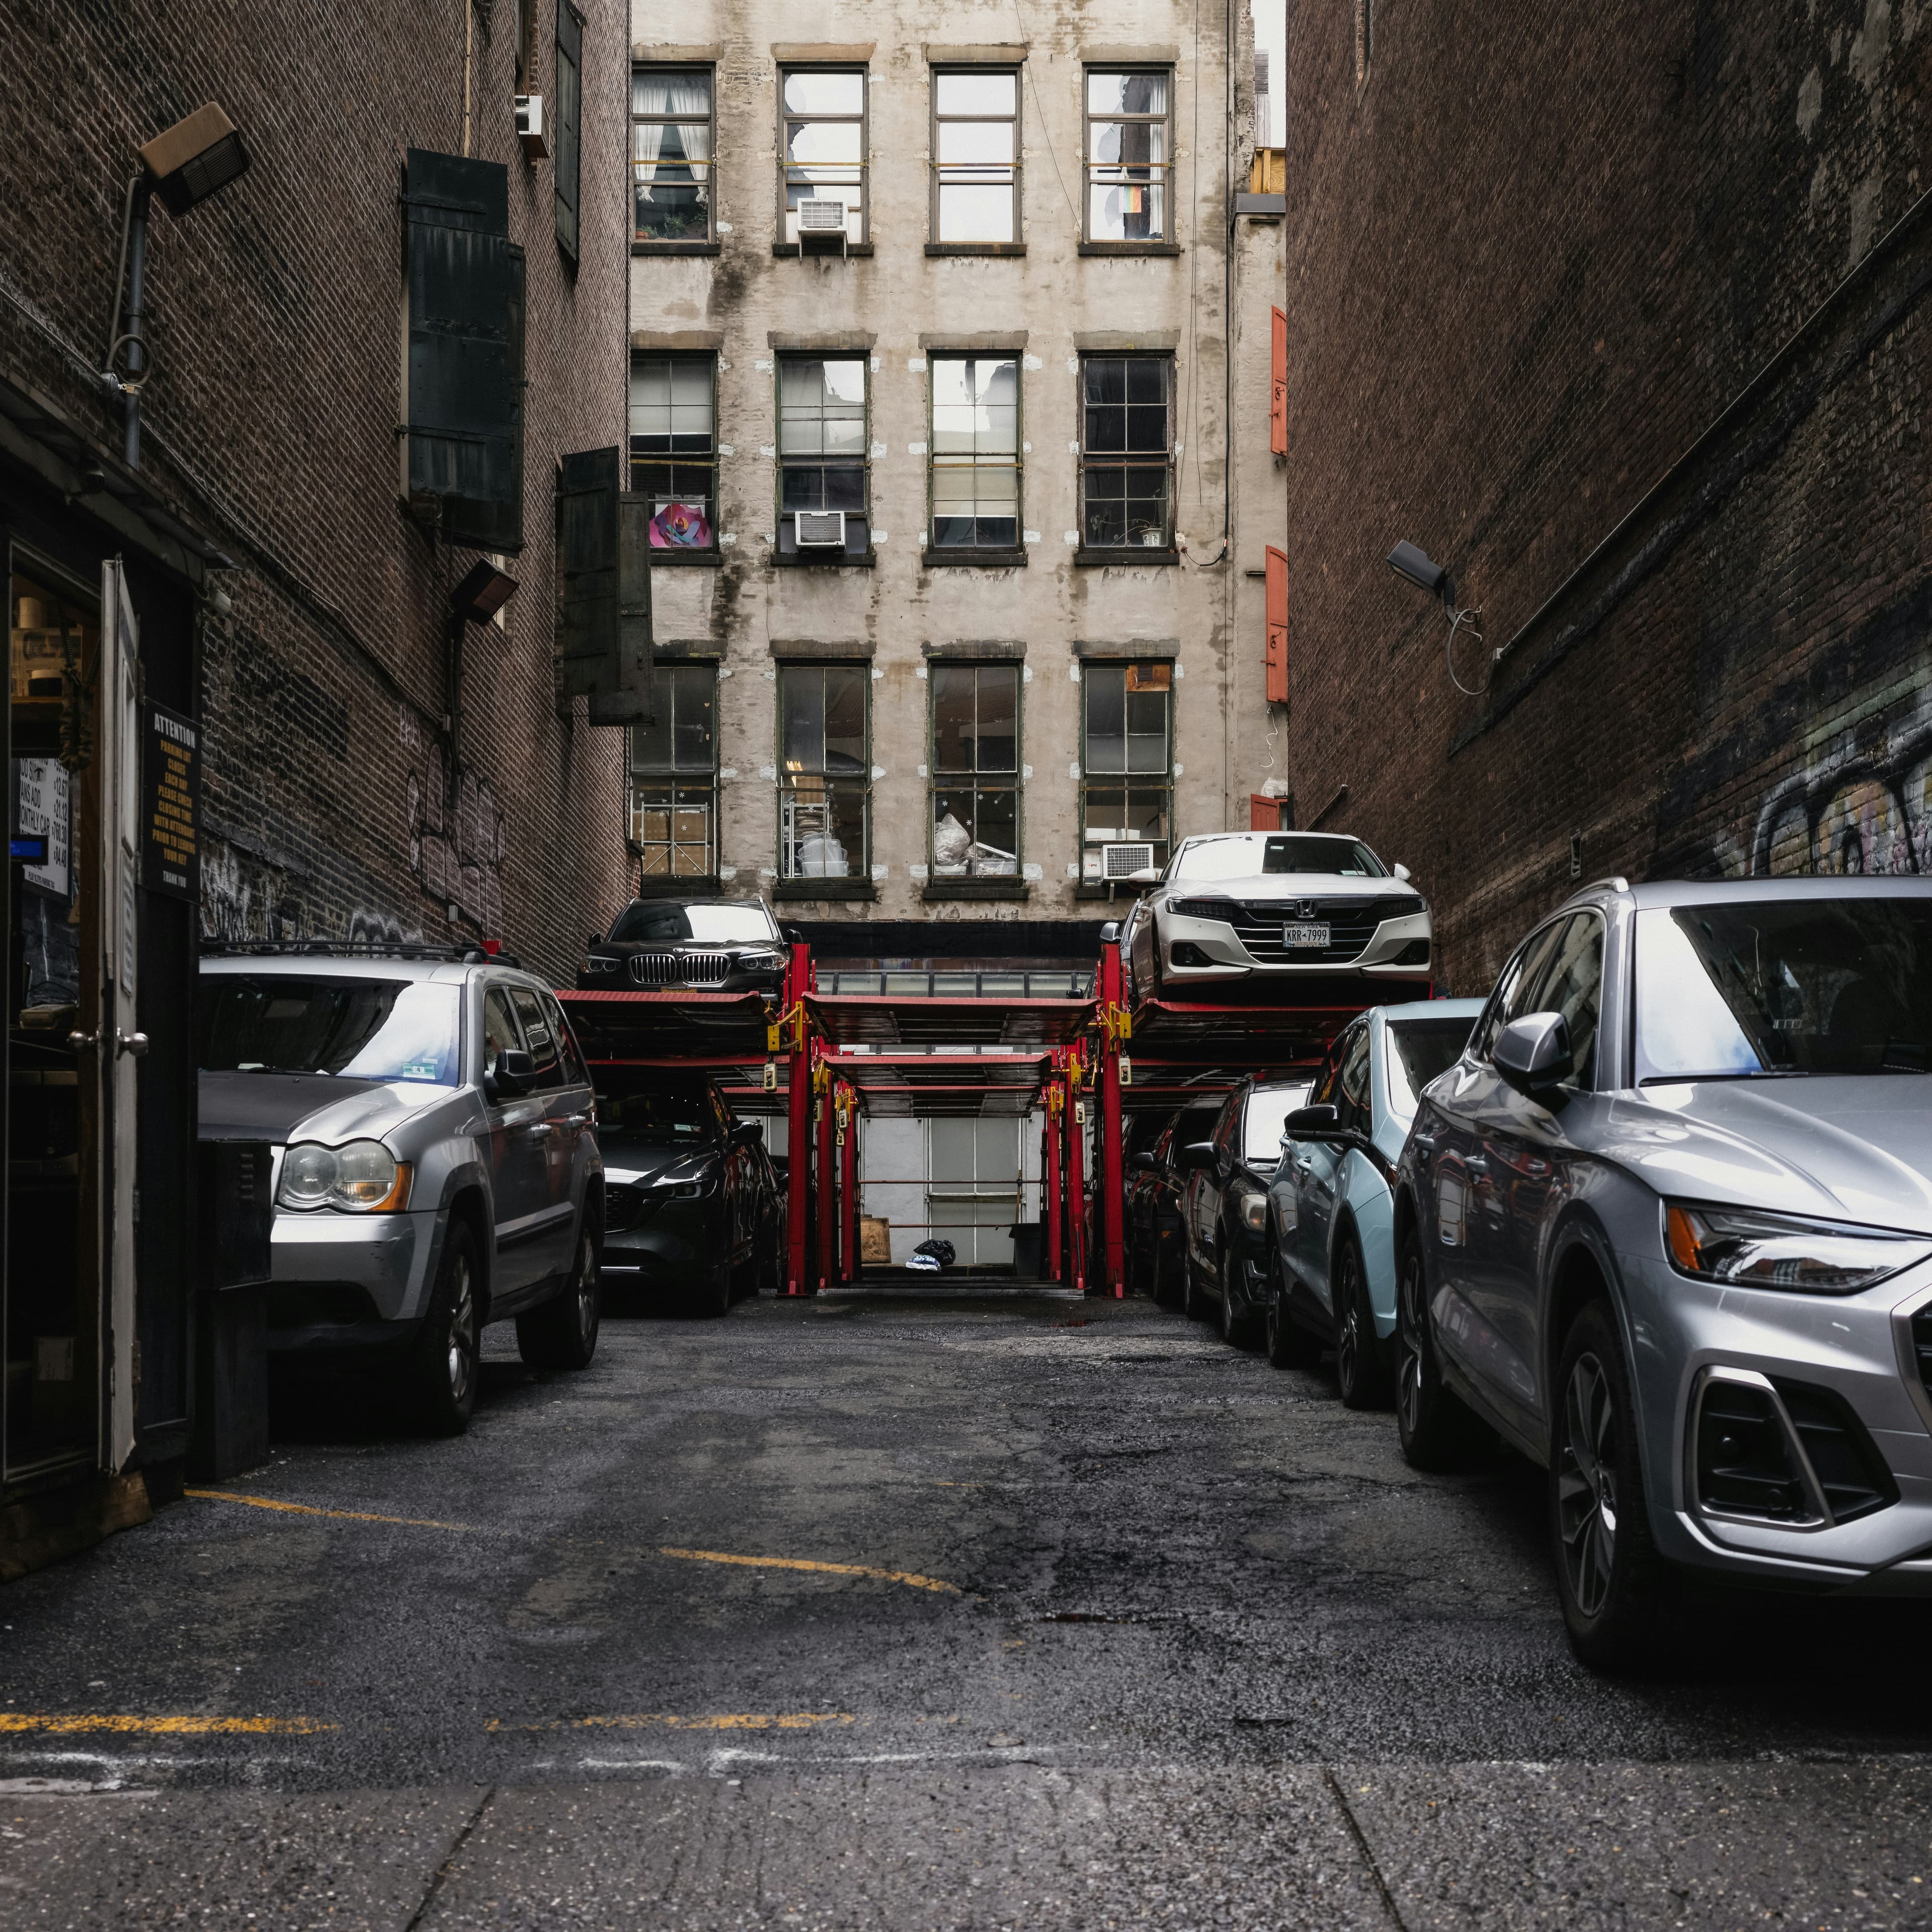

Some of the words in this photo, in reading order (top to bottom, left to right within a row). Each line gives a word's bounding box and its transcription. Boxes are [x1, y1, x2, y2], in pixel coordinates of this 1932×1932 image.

[154, 712, 195, 749] ATTENTION
[160, 740, 183, 760] PARKING
[183, 750, 192, 764] LOT
[168, 757, 186, 776] CLOSES
[54, 776, 67, 798] $12.67
[165, 771, 178, 787] EACH
[179, 777, 188, 791] DAY
[20, 780, 30, 803] ANS
[31, 785, 40, 809] ADD
[54, 799, 67, 822] $21.12
[158, 784, 177, 802] PLEASE
[177, 792, 192, 809] CHECK
[153, 813, 169, 829] WITH
[158, 799, 181, 819] CLOSING
[181, 809, 192, 824] TIME
[20, 805, 39, 832] ONTHLY
[40, 814, 50, 838] CAR
[52, 821, 67, 845] $760.30
[152, 828, 170, 845] PRIOR
[170, 835, 177, 847] TO
[177, 837, 196, 855] LEAVING
[53, 845, 67, 869] $84.48
[163, 847, 177, 863] YOUR
[177, 853, 187, 866] KEY
[163, 870, 177, 886] THANK
[177, 875, 187, 888] YOU
